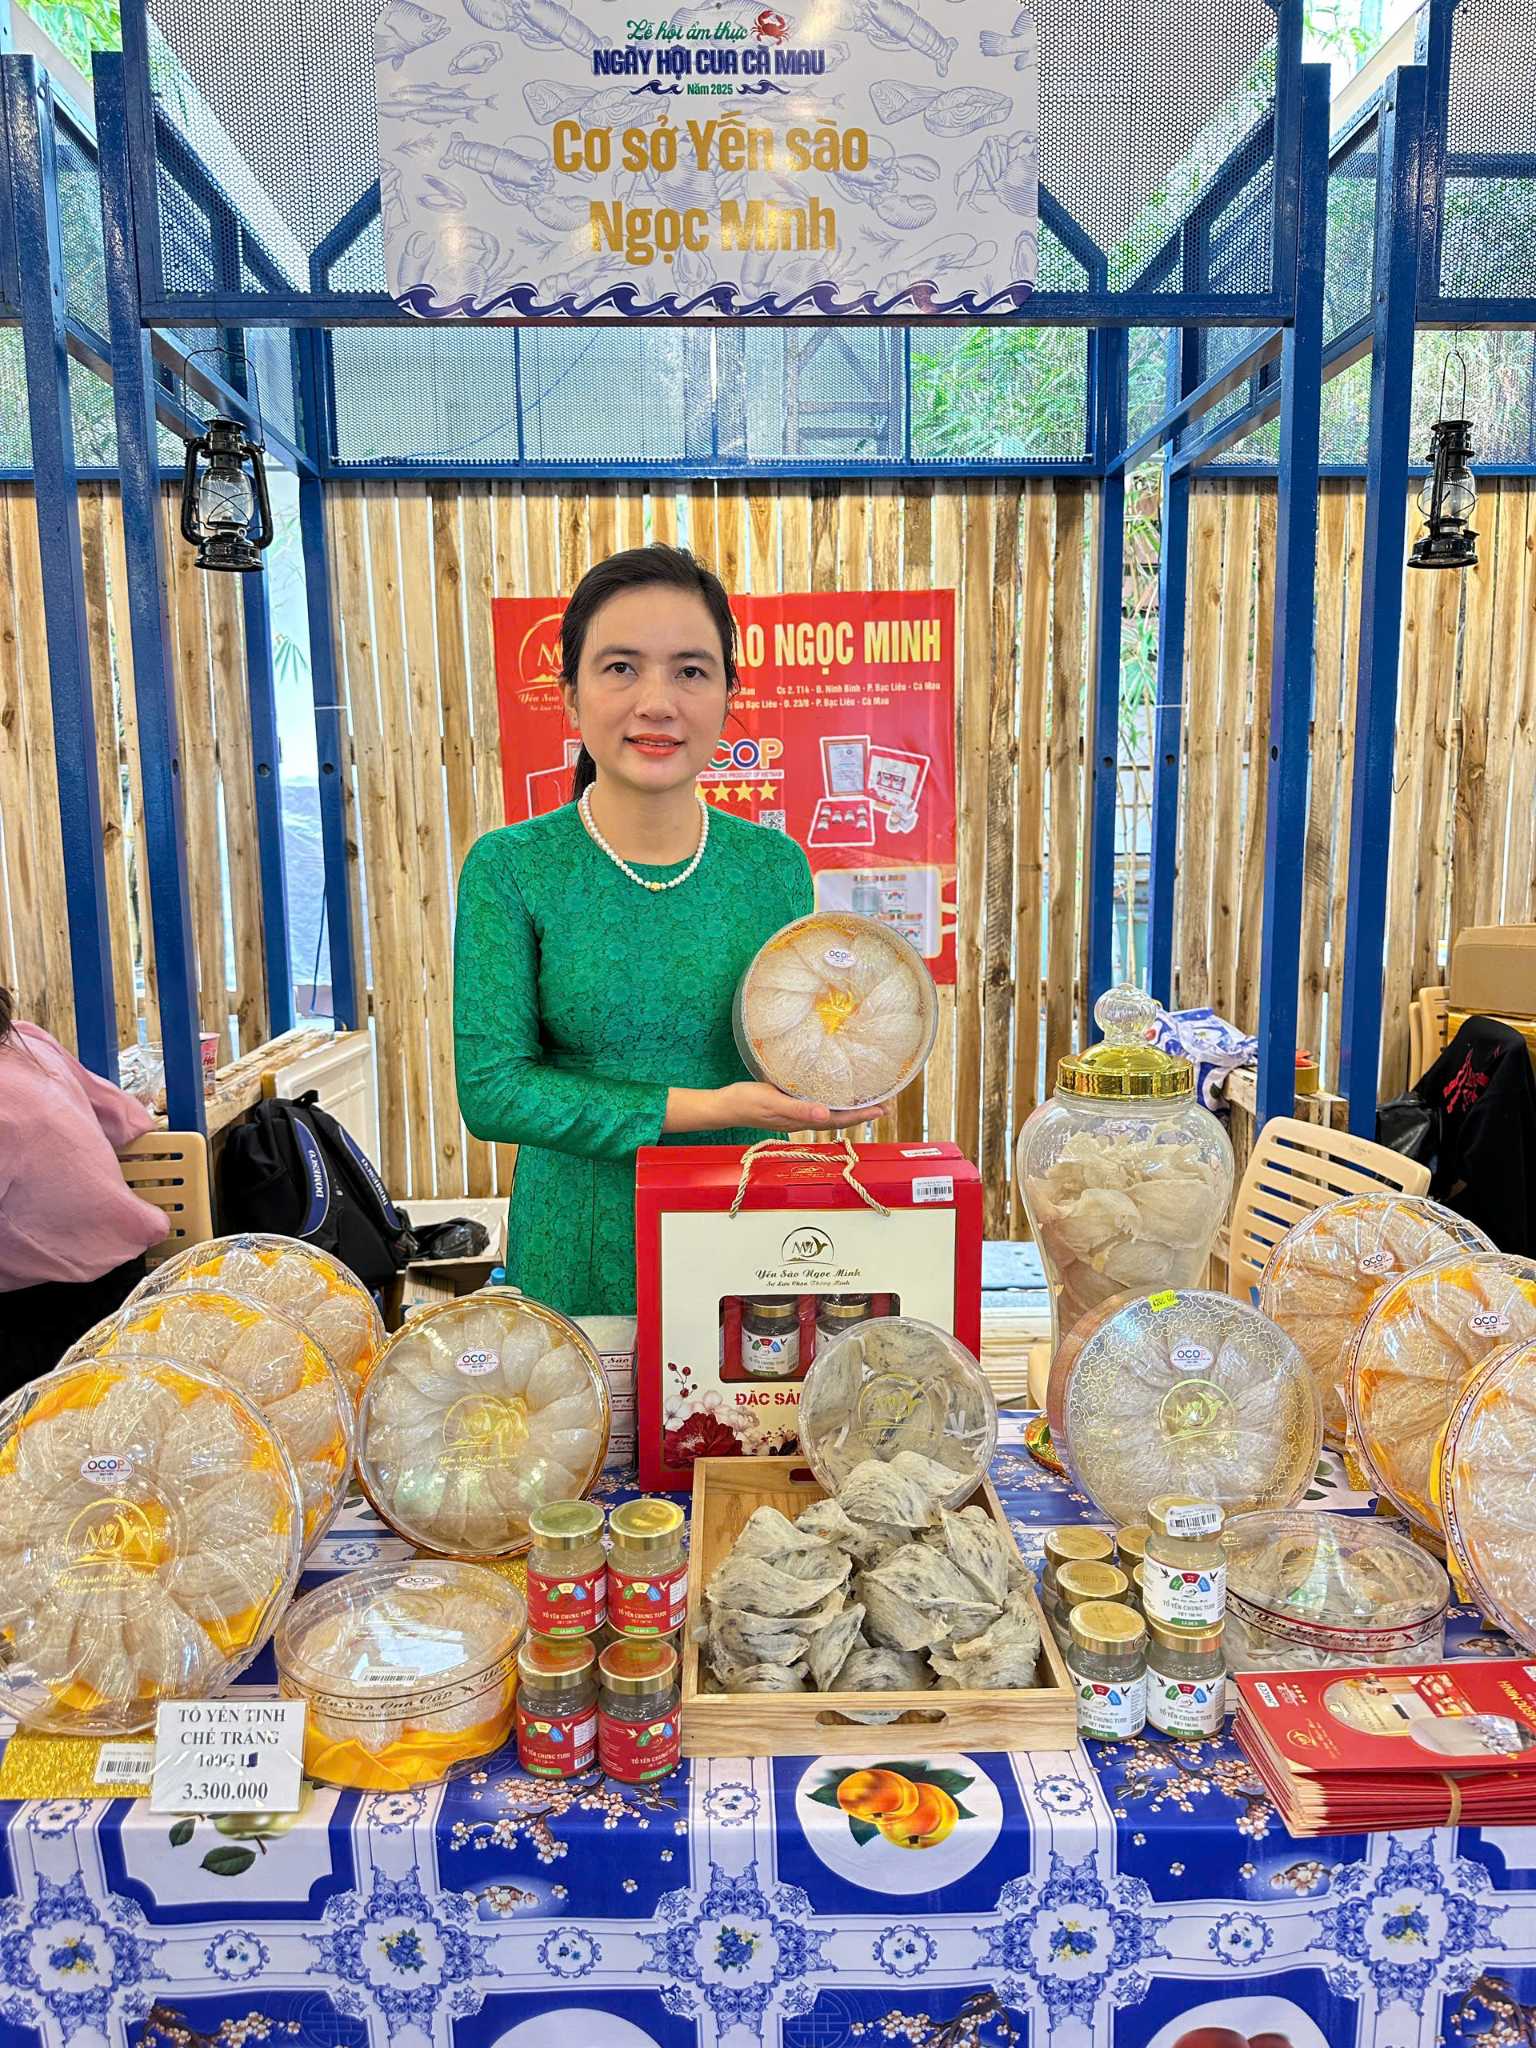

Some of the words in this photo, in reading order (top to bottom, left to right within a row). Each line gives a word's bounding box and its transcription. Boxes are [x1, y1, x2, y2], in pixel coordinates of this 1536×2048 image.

[626, 19, 654, 40] Lễ
[655, 20, 683, 43] hội
[686, 20, 711, 40] ẩm
[713, 20, 748, 43] thực
[593, 45, 654, 76] NGÀY
[656, 44, 692, 80] HỘI
[695, 48, 738, 75] CUA
[742, 45, 771, 75] CÀ
[774, 48, 826, 75] MAU
[687, 82, 709, 95] Năm
[710, 84, 733, 95] 2025
[552, 119, 612, 173] Cơ
[621, 114, 678, 173] sở
[685, 110, 774, 172] Yến
[785, 117, 869, 173] sào
[589, 200, 709, 266] Ngọc
[720, 197, 836, 251] Minh
[774, 621, 854, 675] NGỌC
[864, 619, 941, 664] MINH
[708, 738, 784, 770] COP
[308, 1149, 325, 1198] DOMESCO
[462, 1353, 493, 1363] OCOP
[734, 1389, 770, 1408] ĐẶC
[88, 1460, 125, 1470] OCOP
[182, 1782, 269, 1800] 3.300.000
